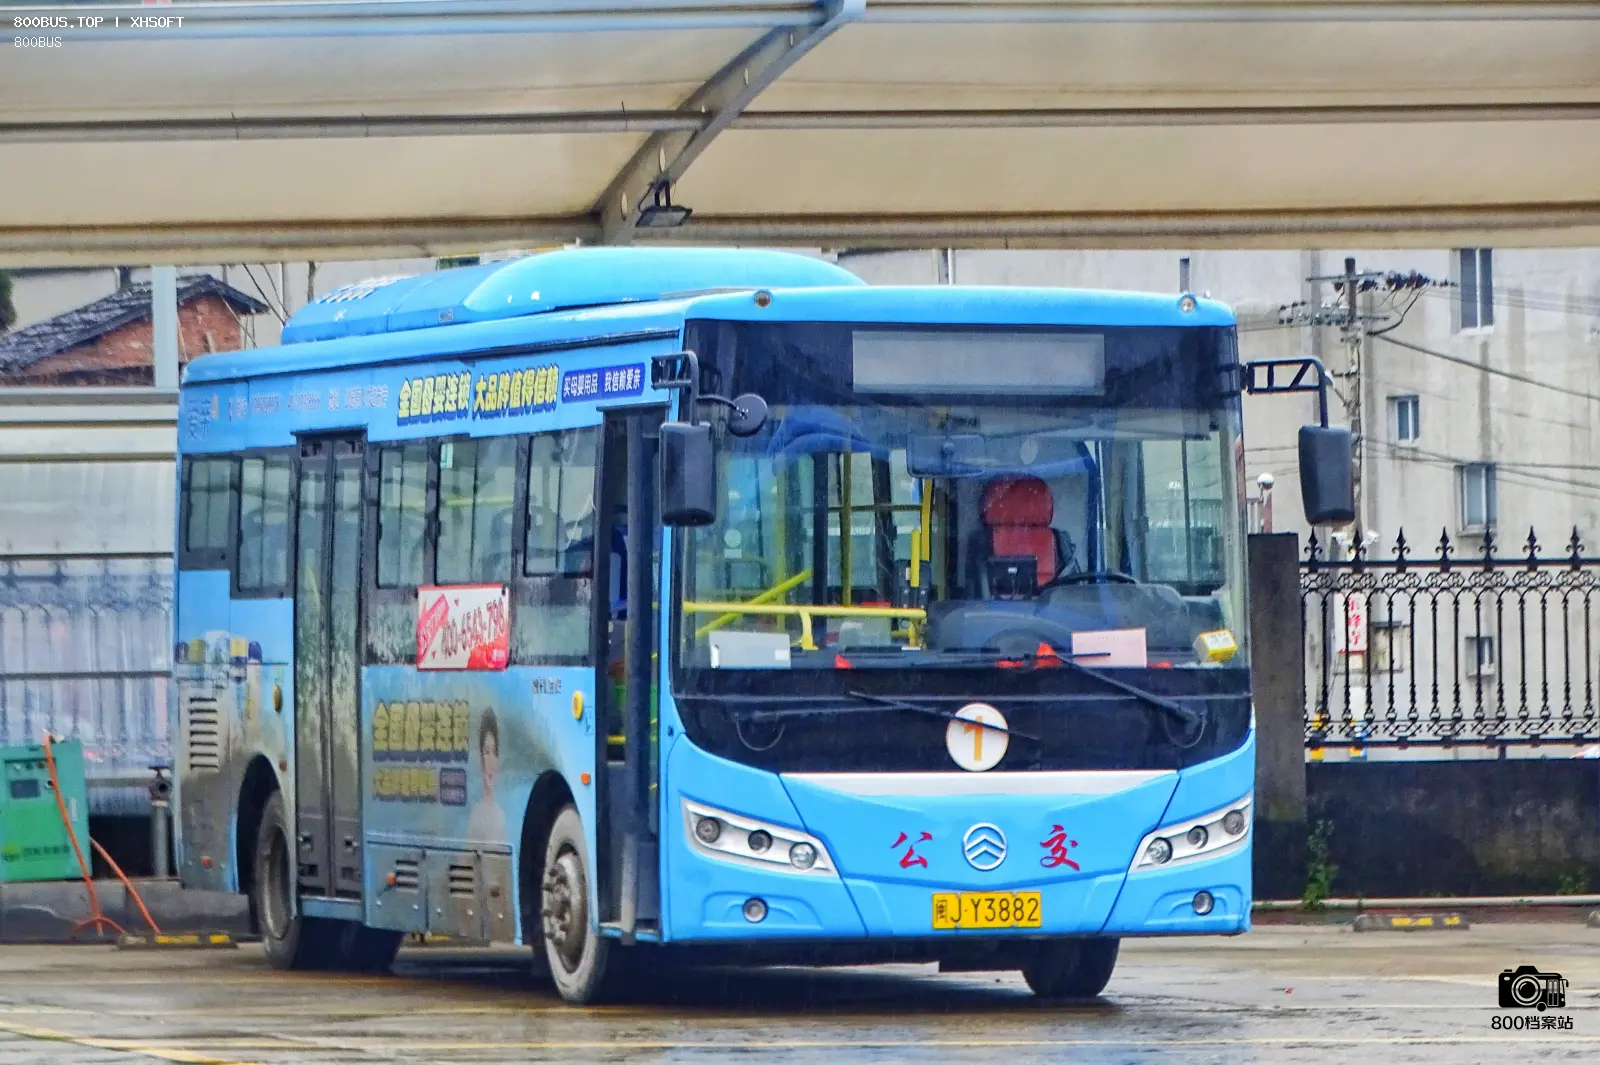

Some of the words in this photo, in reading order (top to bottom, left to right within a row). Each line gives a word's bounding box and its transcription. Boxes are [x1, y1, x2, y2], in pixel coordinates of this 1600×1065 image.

[397, 371, 471, 423] 全国母婴连锁
[473, 365, 560, 418] 大品牌值得信赖
[964, 715, 983, 762] 1
[891, 831, 933, 869] 公
[1040, 824, 1080, 871] 交
